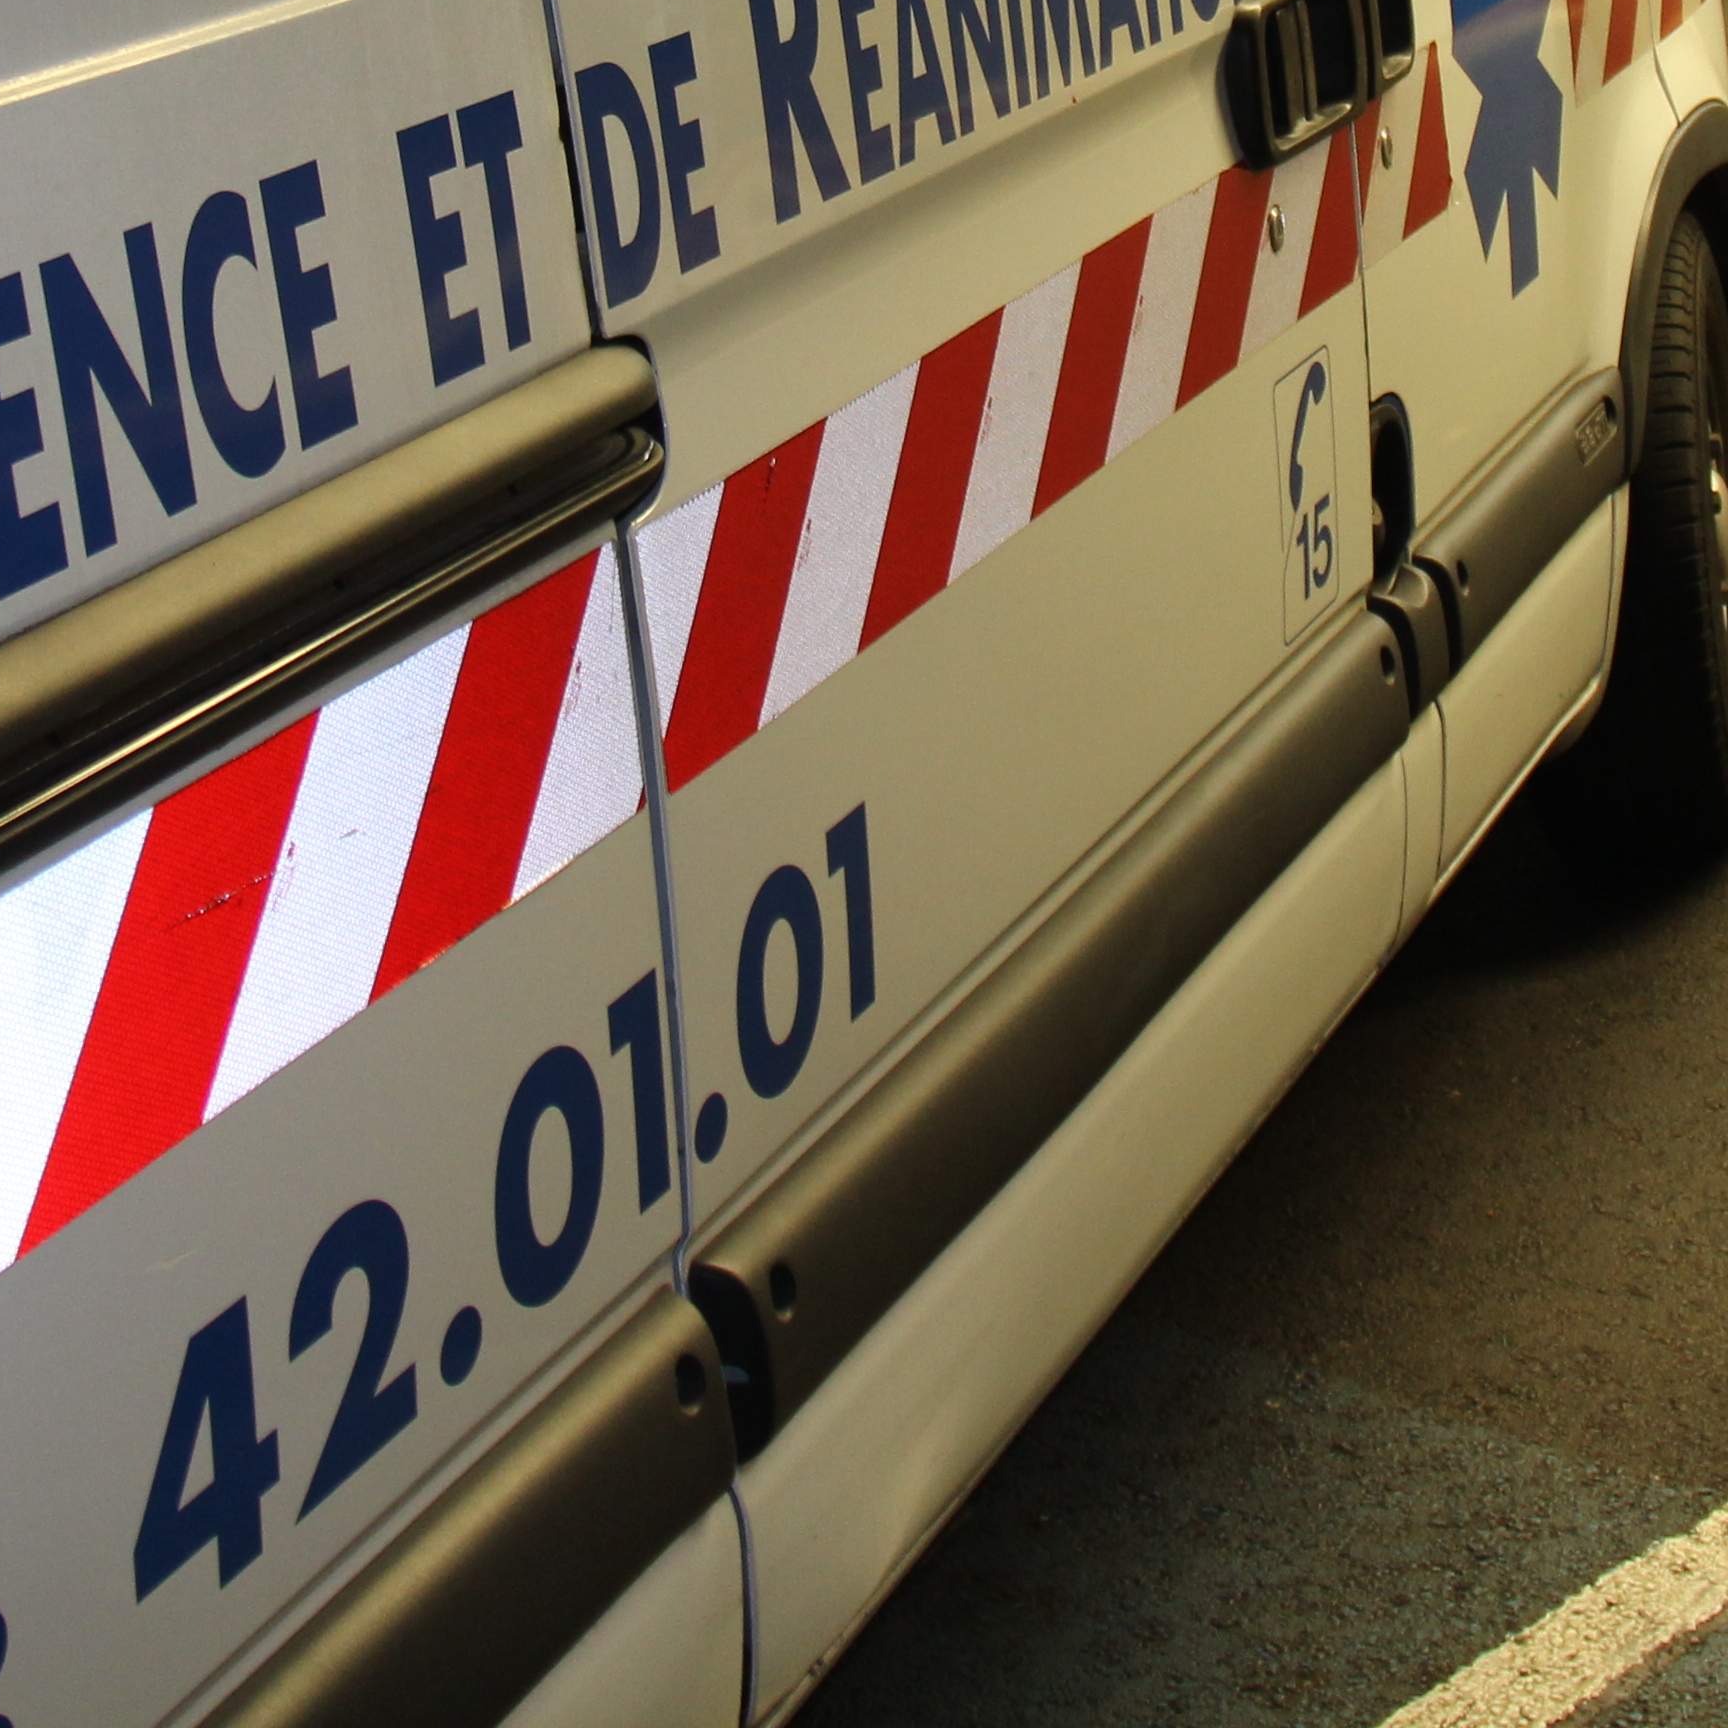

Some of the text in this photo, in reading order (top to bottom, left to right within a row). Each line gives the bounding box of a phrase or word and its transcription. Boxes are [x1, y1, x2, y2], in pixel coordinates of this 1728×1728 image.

[395, 90, 531, 388] ET
[574, 30, 721, 309] DE
[1296, 493, 1333, 600] 15
[133, 801, 876, 1605] 42.01.01
